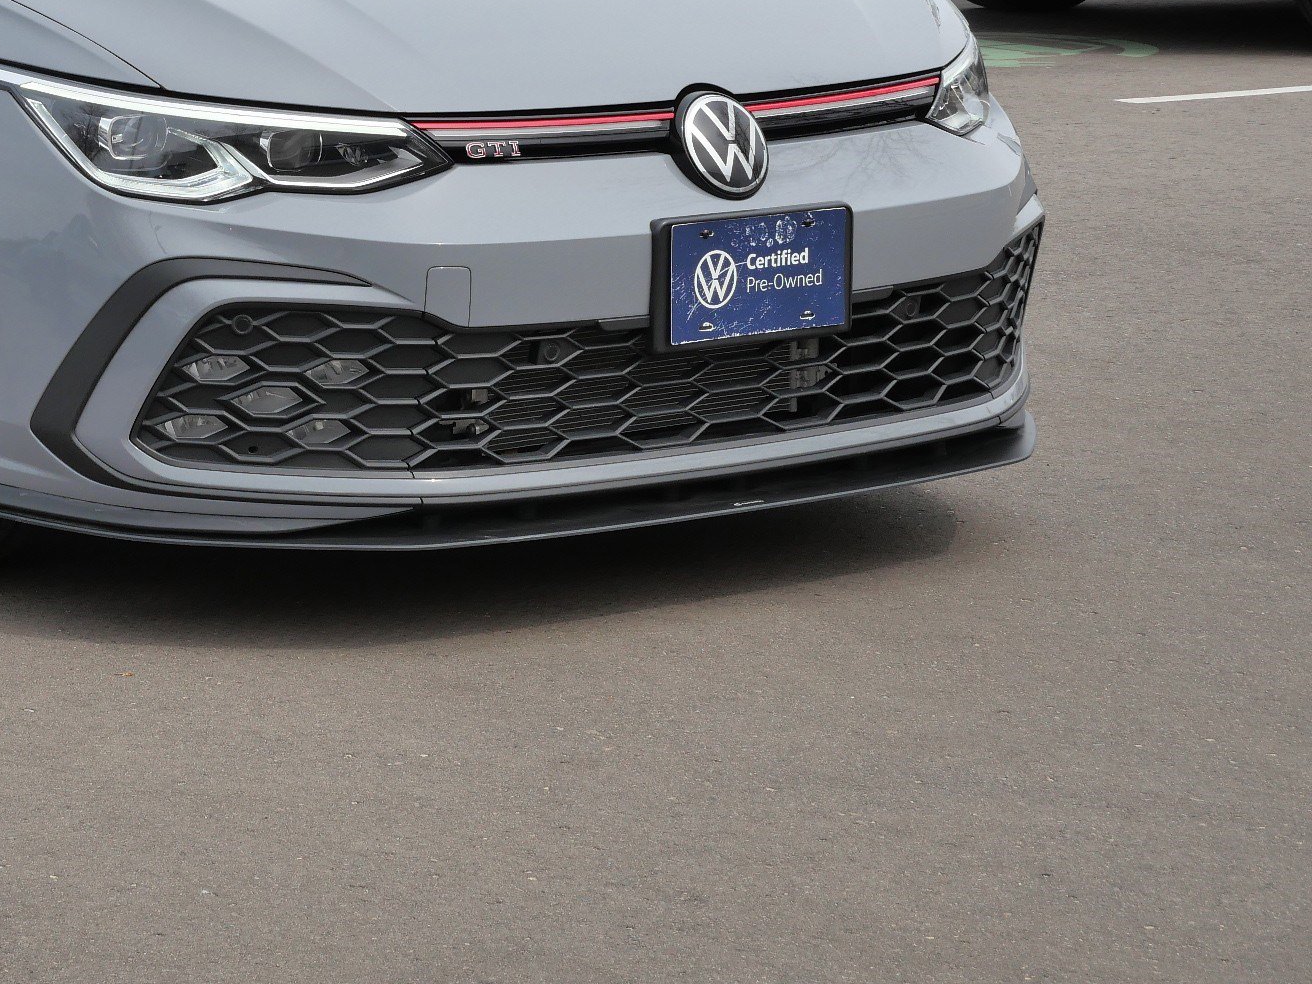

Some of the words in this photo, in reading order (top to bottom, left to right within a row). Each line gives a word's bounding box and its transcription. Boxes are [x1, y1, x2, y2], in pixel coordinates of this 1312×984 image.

[466, 140, 521, 158] GTI
[746, 247, 809, 270] Certified
[746, 269, 823, 293] Pre-Owned
